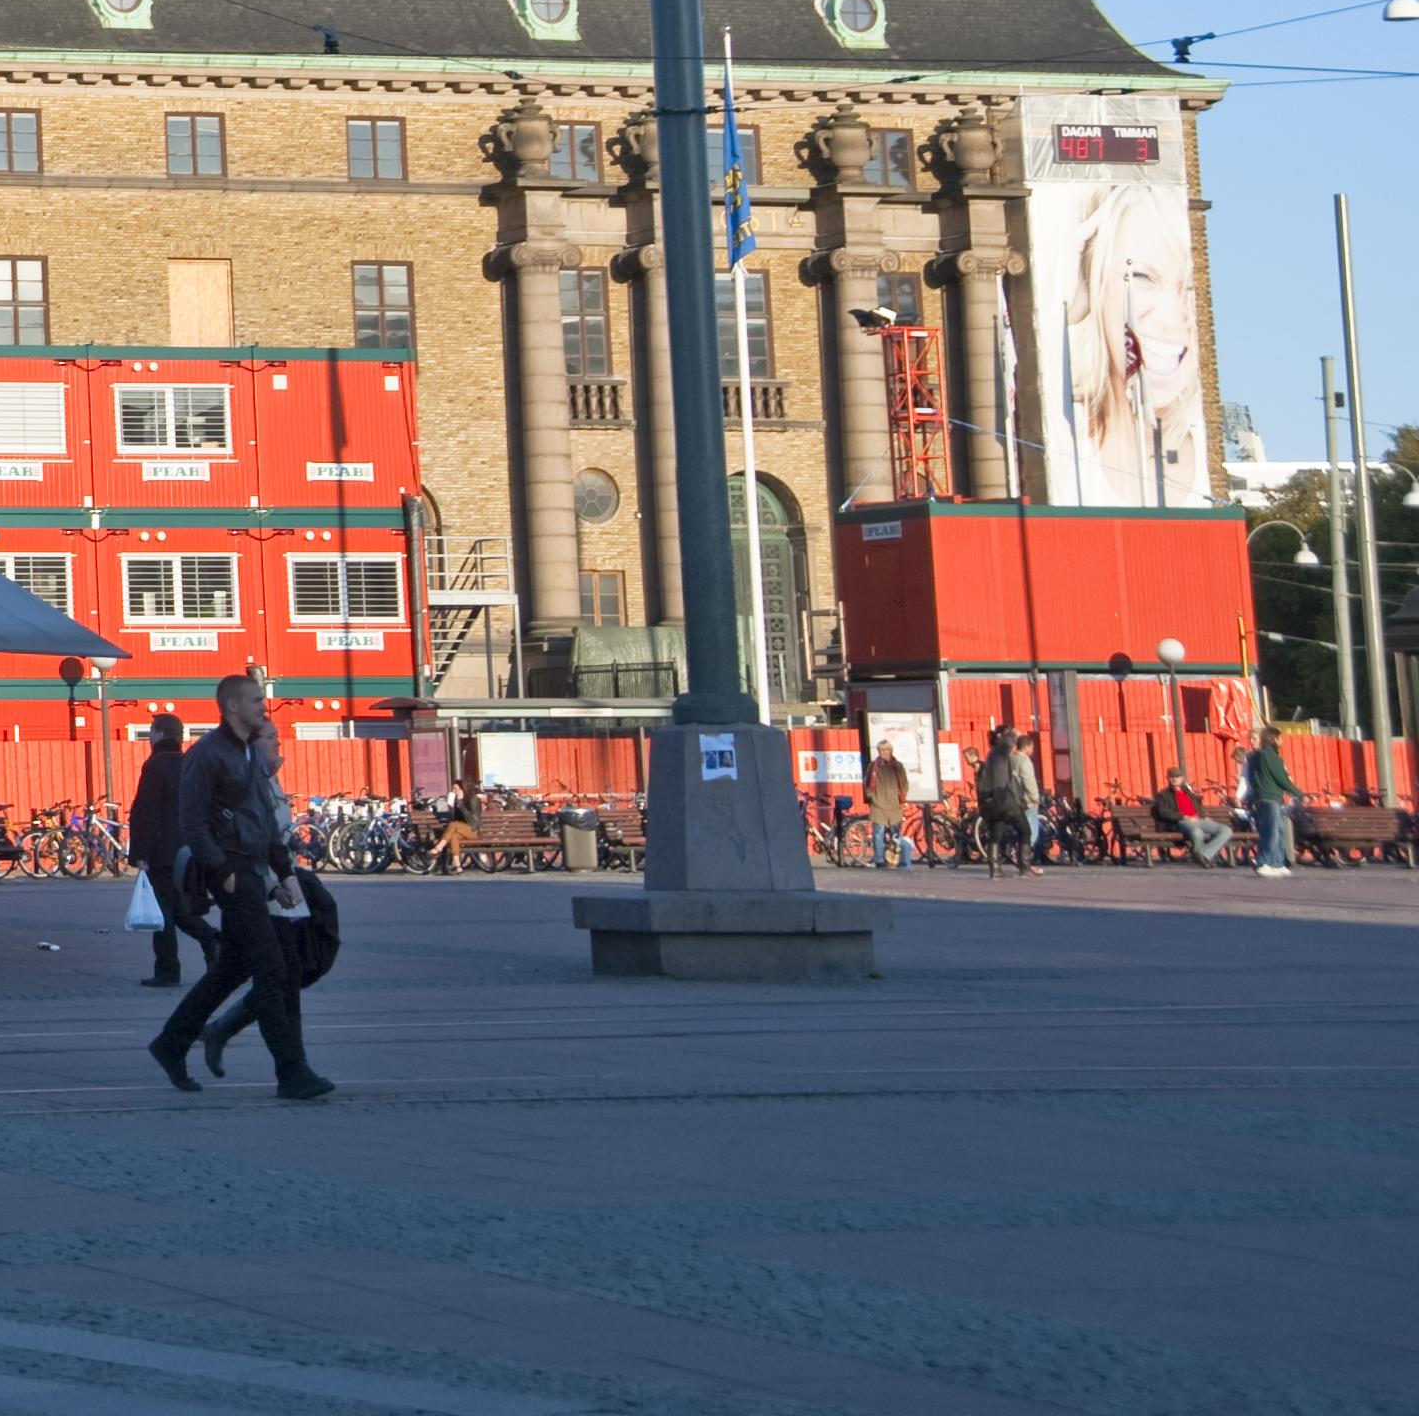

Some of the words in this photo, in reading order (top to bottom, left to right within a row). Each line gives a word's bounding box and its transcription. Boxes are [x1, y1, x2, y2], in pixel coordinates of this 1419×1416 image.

[1061, 126, 1102, 137] DAGAR
[1113, 127, 1157, 138] TIMMAR
[1136, 139, 1148, 160] 3
[152, 466, 200, 477] PEAB
[316, 466, 364, 477] PEAB
[160, 636, 208, 646] PEAB
[326, 636, 374, 646] PEAB
